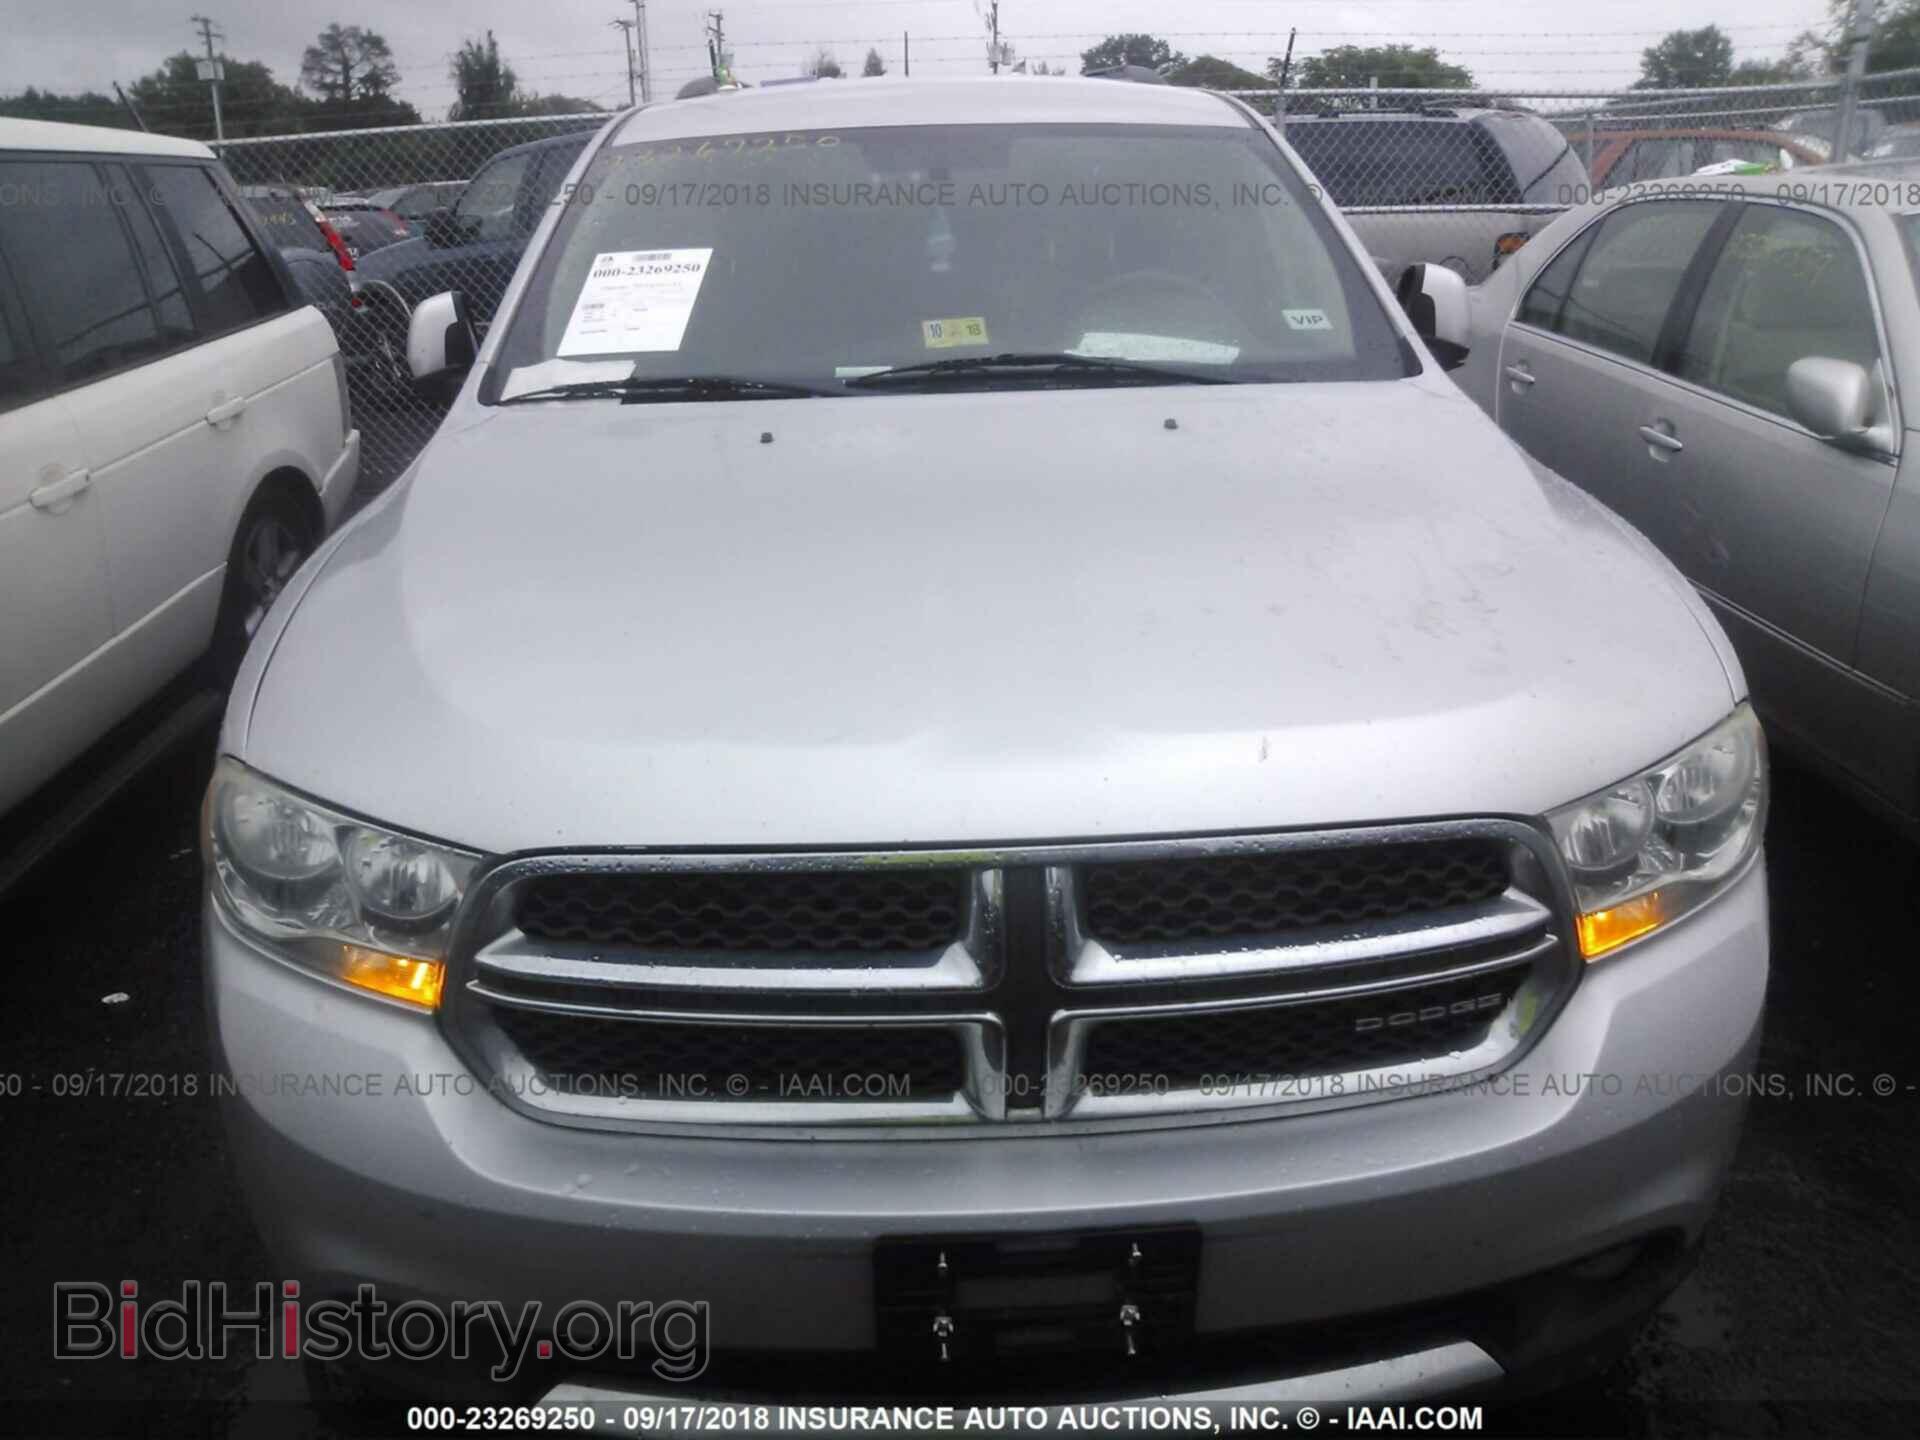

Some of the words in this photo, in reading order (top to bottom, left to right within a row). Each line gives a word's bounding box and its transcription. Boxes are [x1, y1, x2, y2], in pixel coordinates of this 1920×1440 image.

[592, 263, 702, 280] 000-23269250
[1290, 314, 1323, 326] VIP
[1354, 992, 1503, 1032] DODGE
